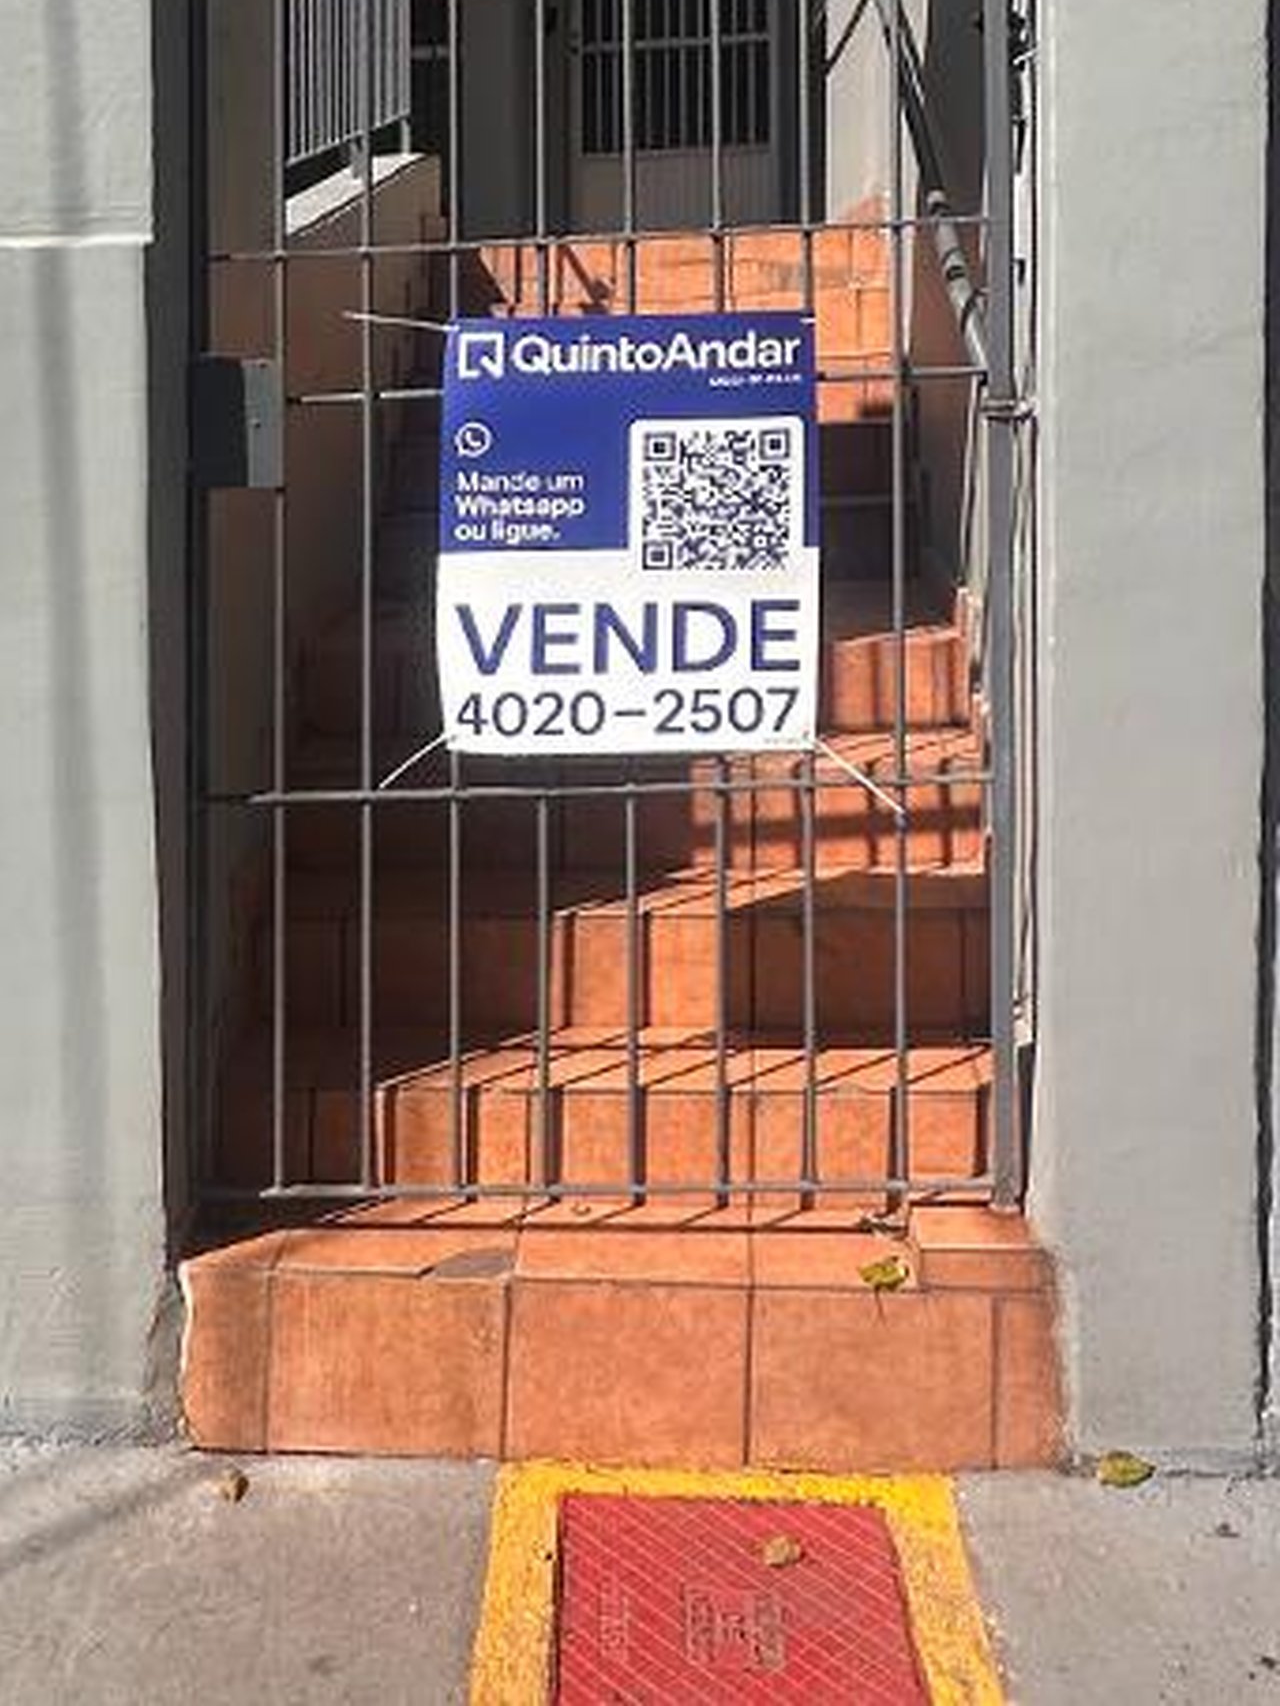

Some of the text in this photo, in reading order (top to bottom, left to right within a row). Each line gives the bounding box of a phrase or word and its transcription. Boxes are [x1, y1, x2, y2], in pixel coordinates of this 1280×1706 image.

[512, 330, 801, 375] QuintoAndar
[457, 471, 584, 492] Mande um
[454, 494, 585, 520] Whatsapp
[454, 518, 562, 545] ou ligue.
[454, 599, 801, 676] VENDE
[456, 687, 800, 737] 4020-2507
